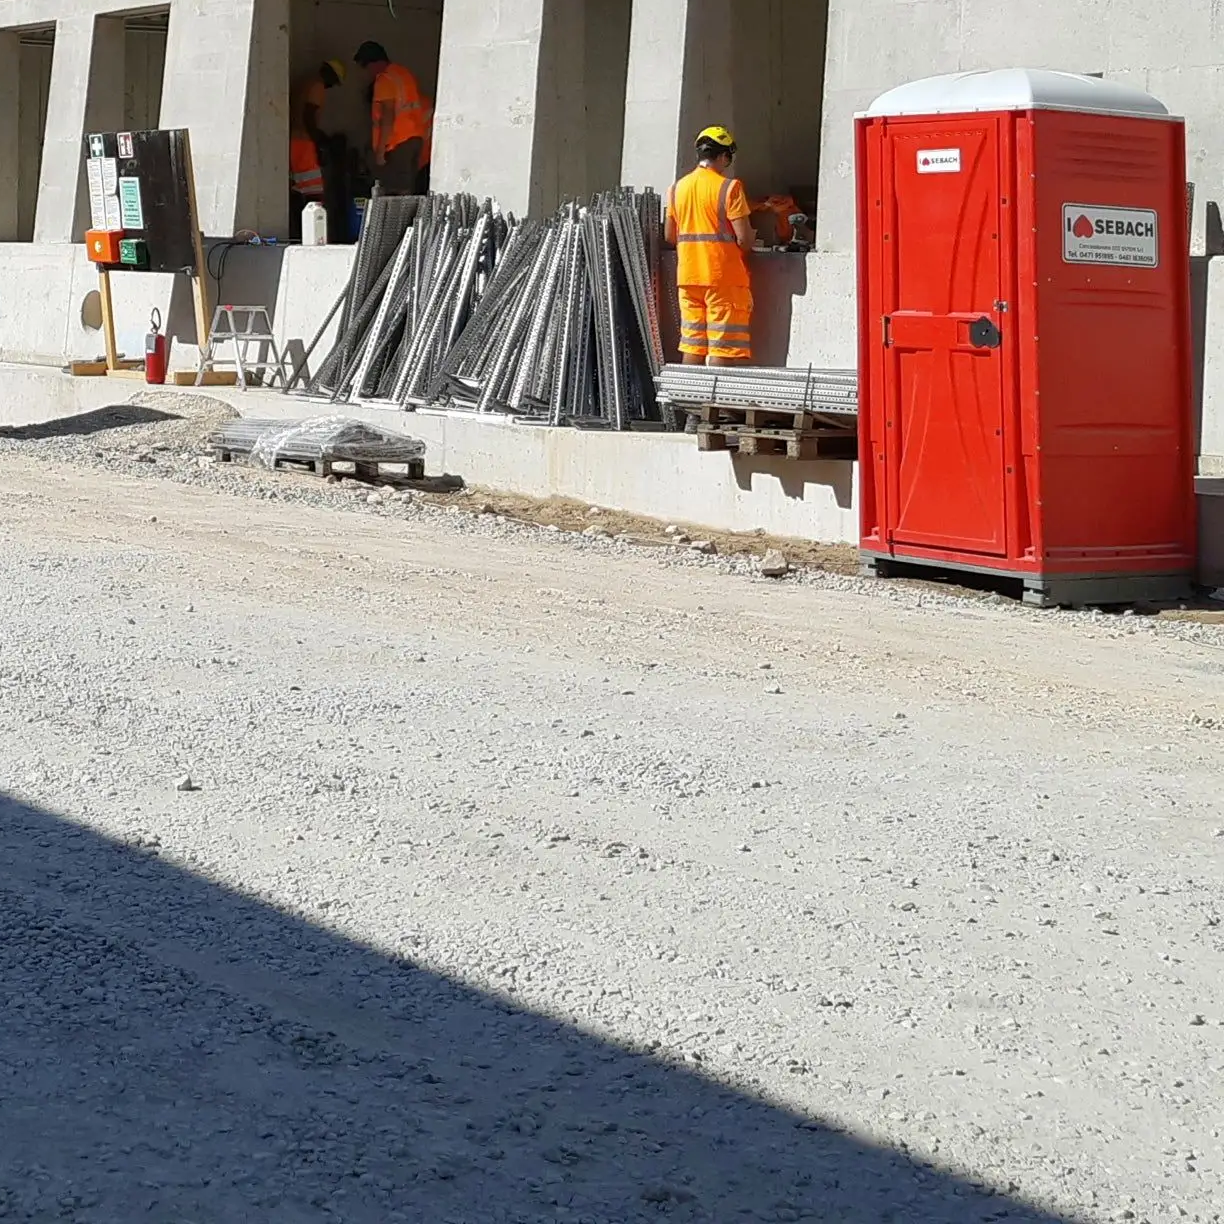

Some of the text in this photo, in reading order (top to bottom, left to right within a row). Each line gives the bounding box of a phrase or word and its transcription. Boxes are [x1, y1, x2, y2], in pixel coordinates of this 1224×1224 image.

[931, 156, 958, 164] SEBACH
[1067, 217, 1154, 238] I SEBACH
